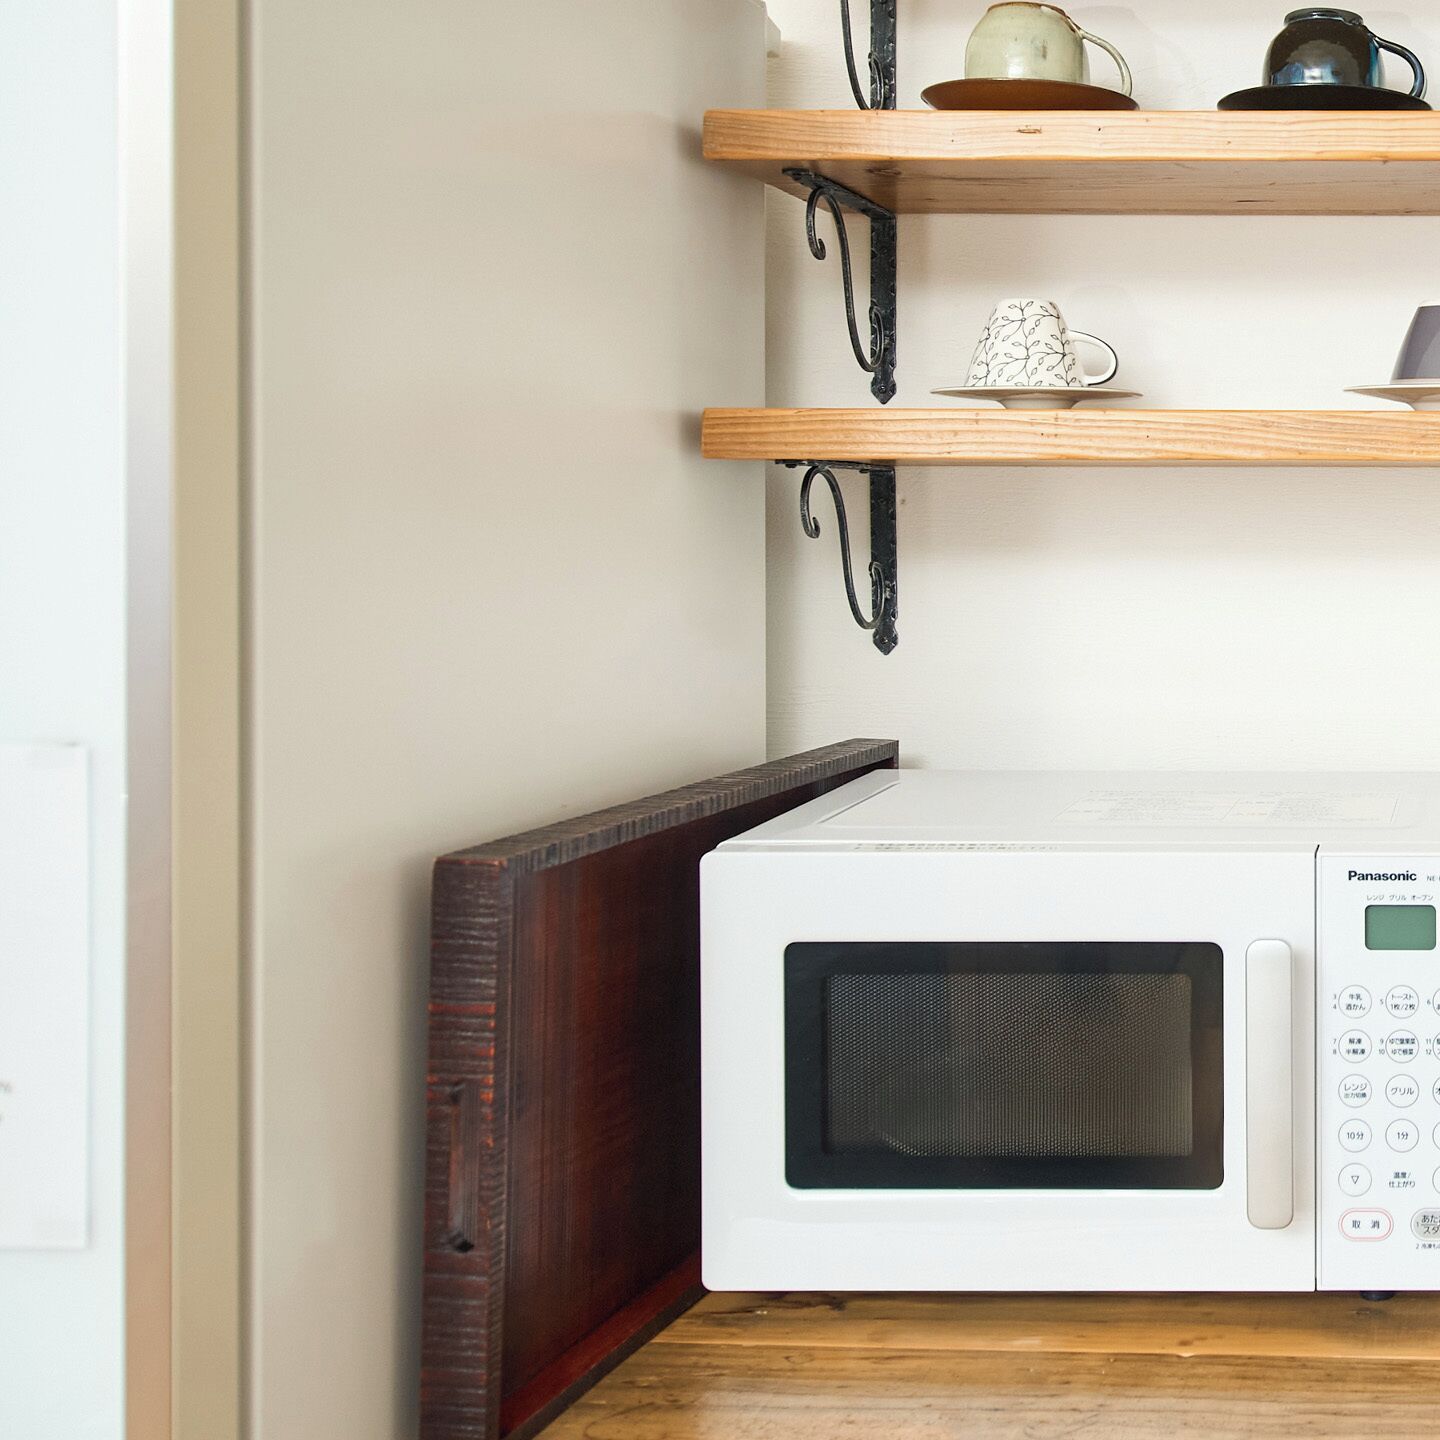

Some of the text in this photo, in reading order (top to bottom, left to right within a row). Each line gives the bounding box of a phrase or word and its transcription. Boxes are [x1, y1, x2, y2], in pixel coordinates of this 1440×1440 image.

[1348, 870, 1417, 881] Panasonic
[1344, 1083, 1367, 1091] レンジ
[1391, 1087, 1414, 1095] グリル
[1347, 1132, 1364, 1140] 10分
[1397, 1132, 1408, 1140] 1分
